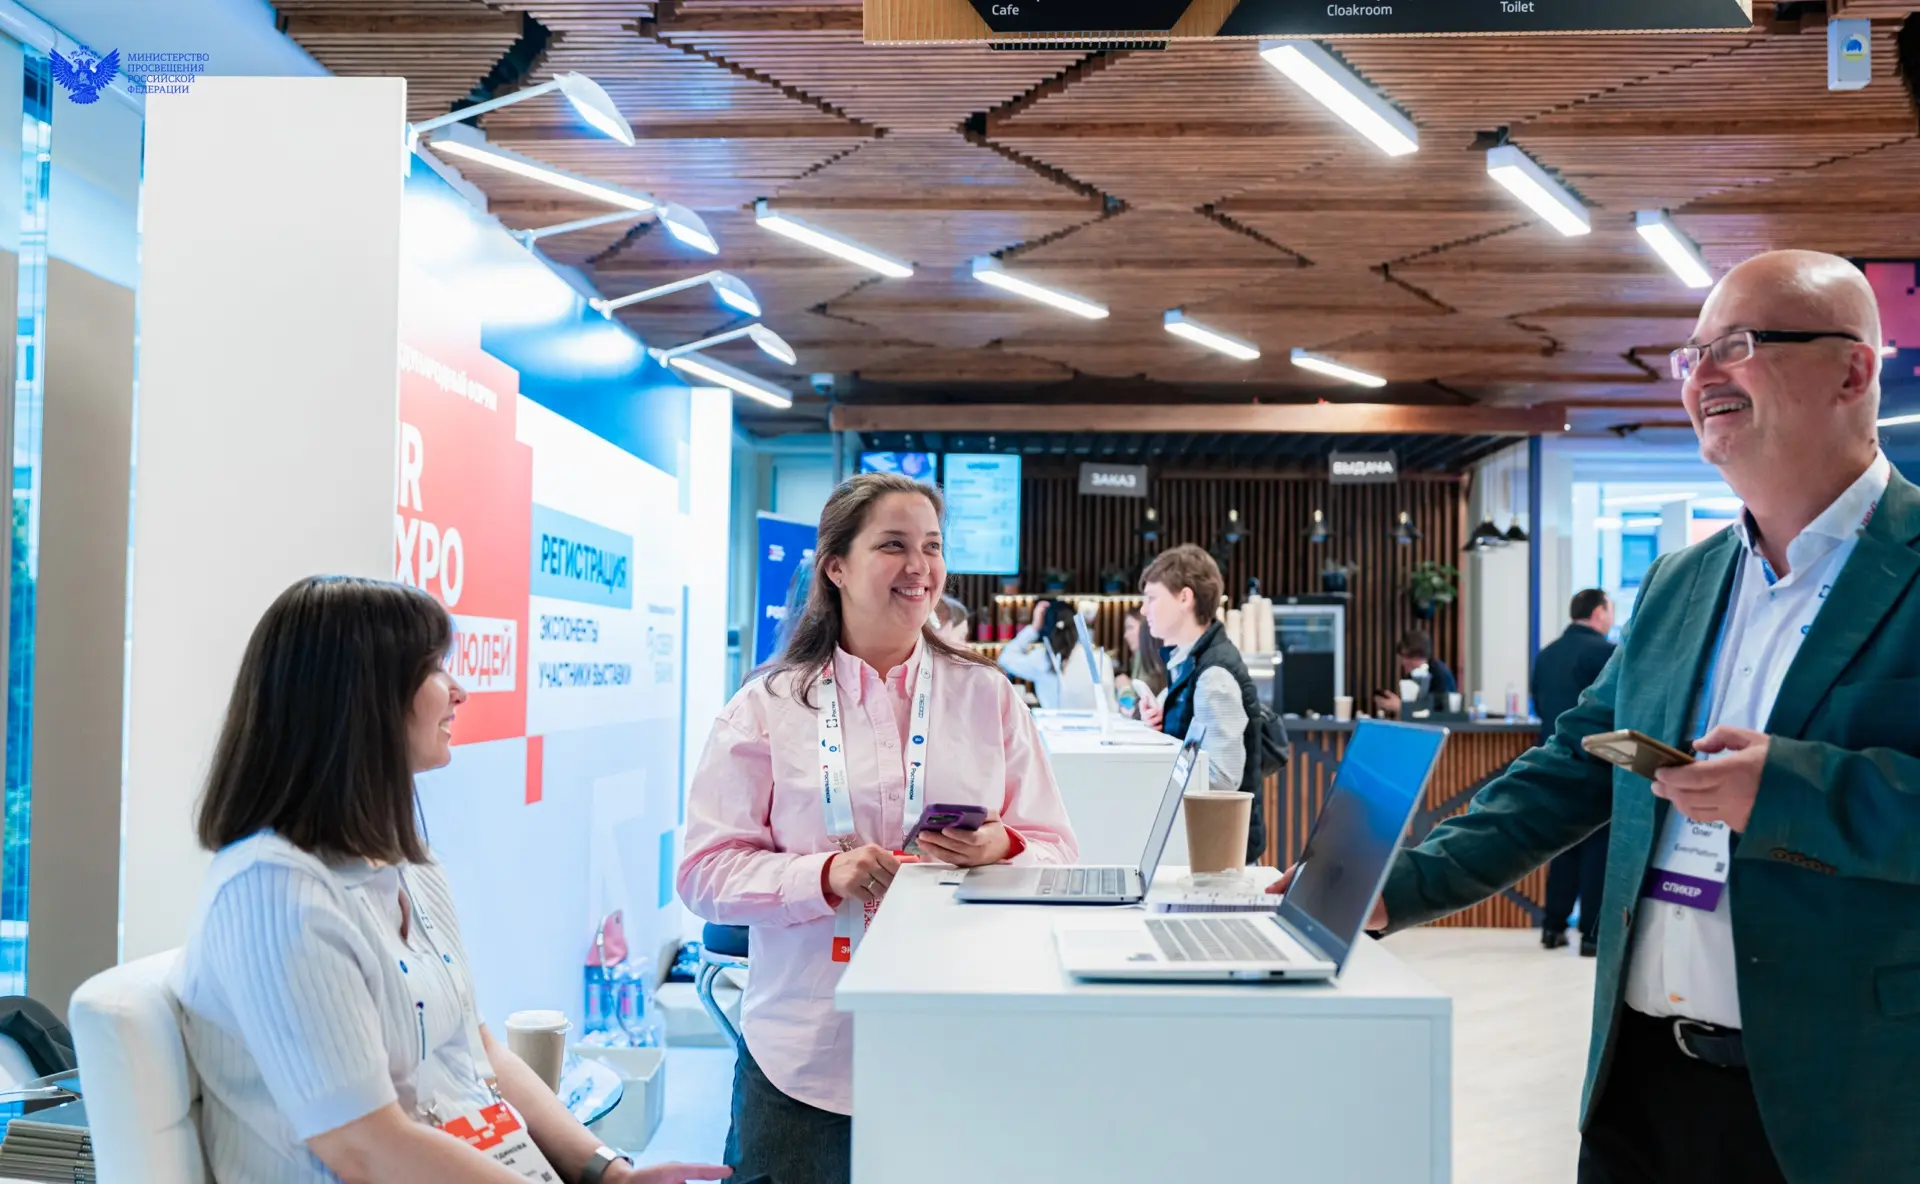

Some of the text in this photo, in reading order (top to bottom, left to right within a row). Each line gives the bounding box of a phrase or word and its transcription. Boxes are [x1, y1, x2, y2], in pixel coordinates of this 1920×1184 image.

[992, 4, 1019, 15] Cafe
[1327, 4, 1393, 16] Cloakroom
[1500, 1, 1535, 13] Toilet
[398, 420, 423, 512] R
[1333, 461, 1394, 476] ВЫДАЧА
[1091, 473, 1136, 488] ЗАКАЗ
[395, 514, 463, 607] XPO
[540, 533, 627, 594] РЕГИСТРАЦИЯ
[540, 614, 598, 643] ЭКСПОНЕНТЫ
[448, 626, 511, 687] ЛЮДЕЙ
[538, 662, 632, 688] УЧАСТНИКИ ВЫСТАВКИ
[1662, 881, 1702, 897] СПИКЕР
